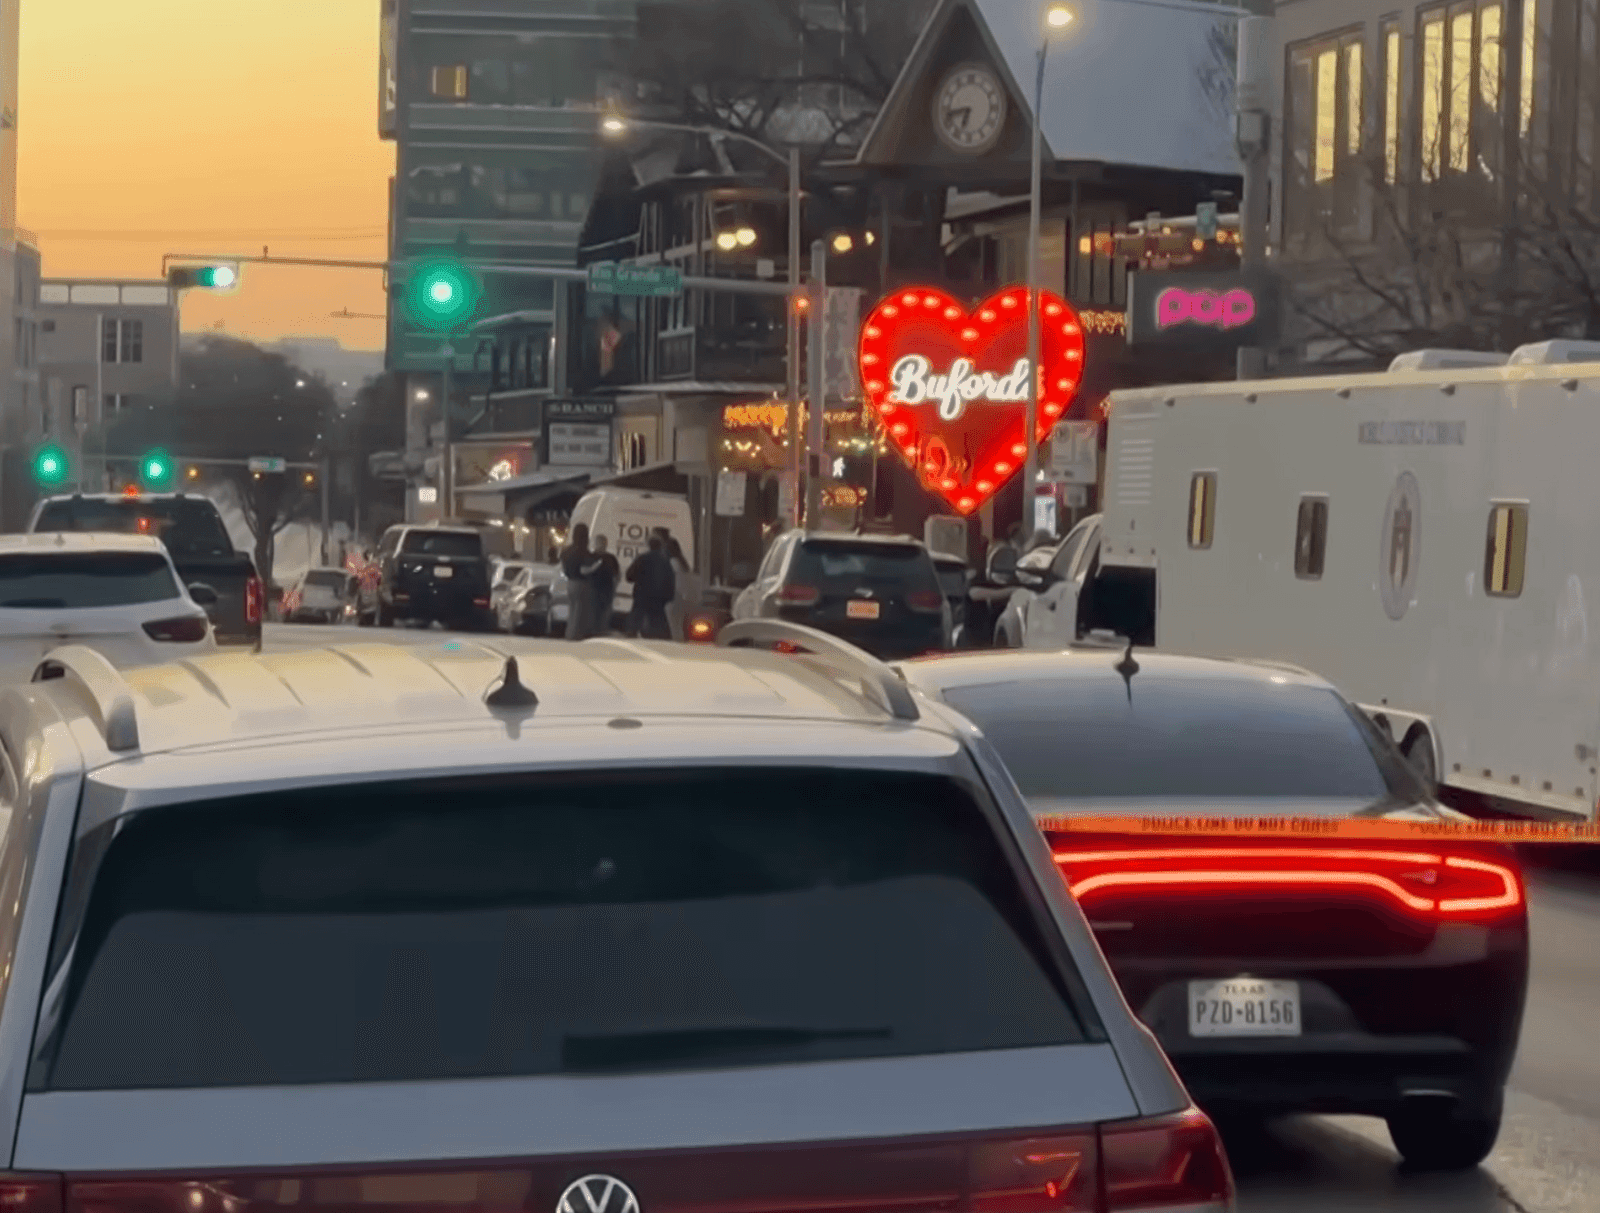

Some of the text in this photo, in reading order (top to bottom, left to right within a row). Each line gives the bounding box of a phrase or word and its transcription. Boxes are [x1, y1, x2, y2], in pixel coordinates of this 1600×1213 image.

[1141, 816, 1192, 831] POLICE
[1197, 817, 1229, 831] LINE
[1234, 817, 1254, 831] DO
[1257, 817, 1286, 831] NOT
[1224, 985, 1266, 994] TEXAS
